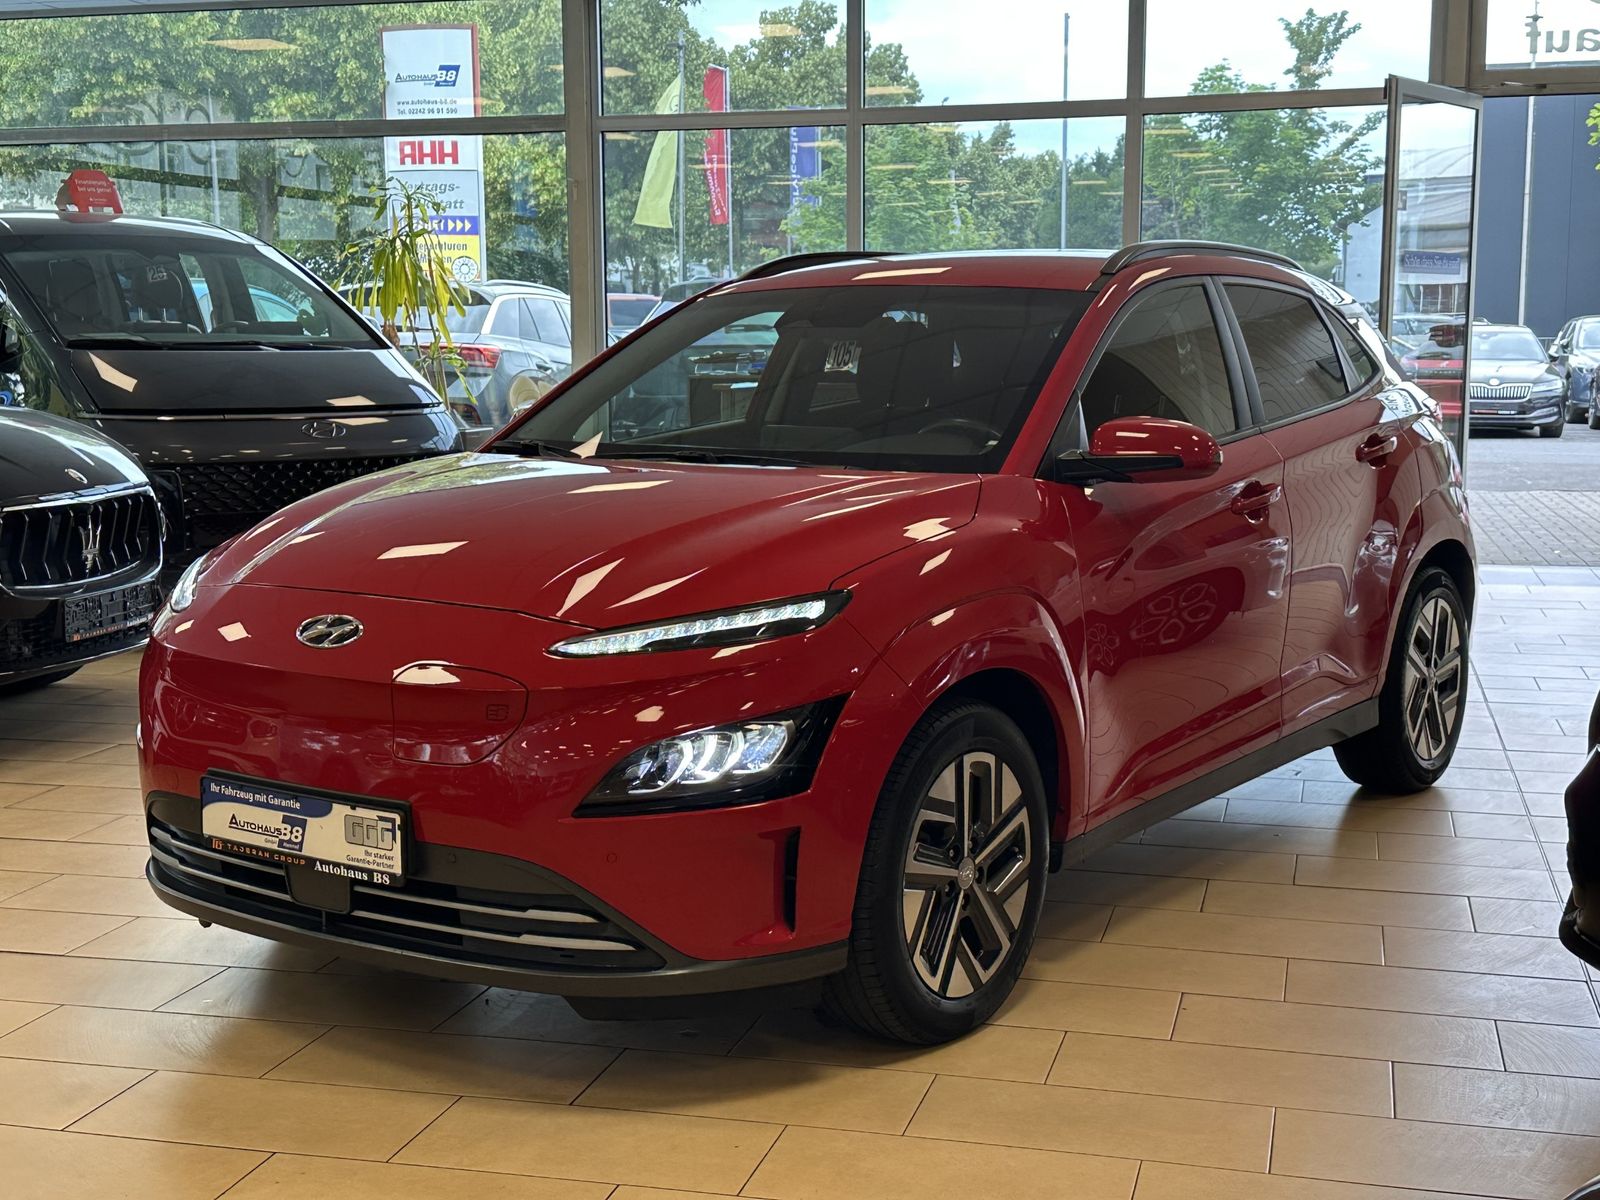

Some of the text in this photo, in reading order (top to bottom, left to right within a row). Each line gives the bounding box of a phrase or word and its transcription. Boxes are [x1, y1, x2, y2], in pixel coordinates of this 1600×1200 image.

[399, 140, 459, 165] AHH
[832, 341, 853, 367] 105
[210, 782, 301, 810] Ihr Fahrzeug mit Garantie
[229, 813, 283, 836] AUTOHAUS
[273, 854, 306, 865] GROUP
[346, 854, 394, 870] Garantie-Partner
[364, 849, 394, 862] Ihr starker
[314, 860, 368, 881] Autohaus
